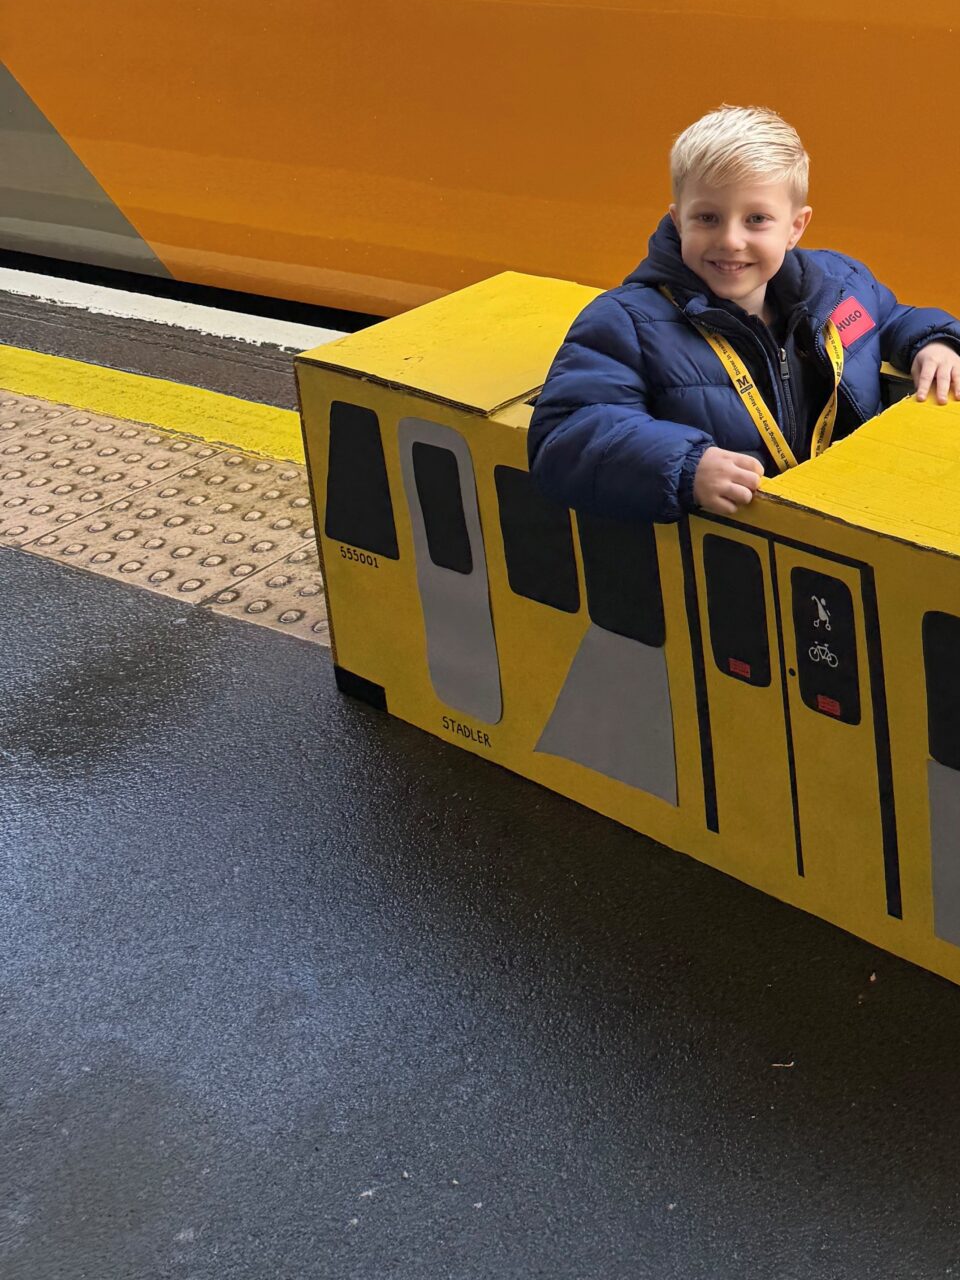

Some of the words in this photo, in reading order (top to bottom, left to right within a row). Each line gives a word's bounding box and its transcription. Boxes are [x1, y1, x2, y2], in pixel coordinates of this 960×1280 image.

[836, 310, 862, 332] HUGO
[736, 375, 749, 388] M
[340, 546, 379, 568] 555001
[442, 715, 492, 748] STADLER
